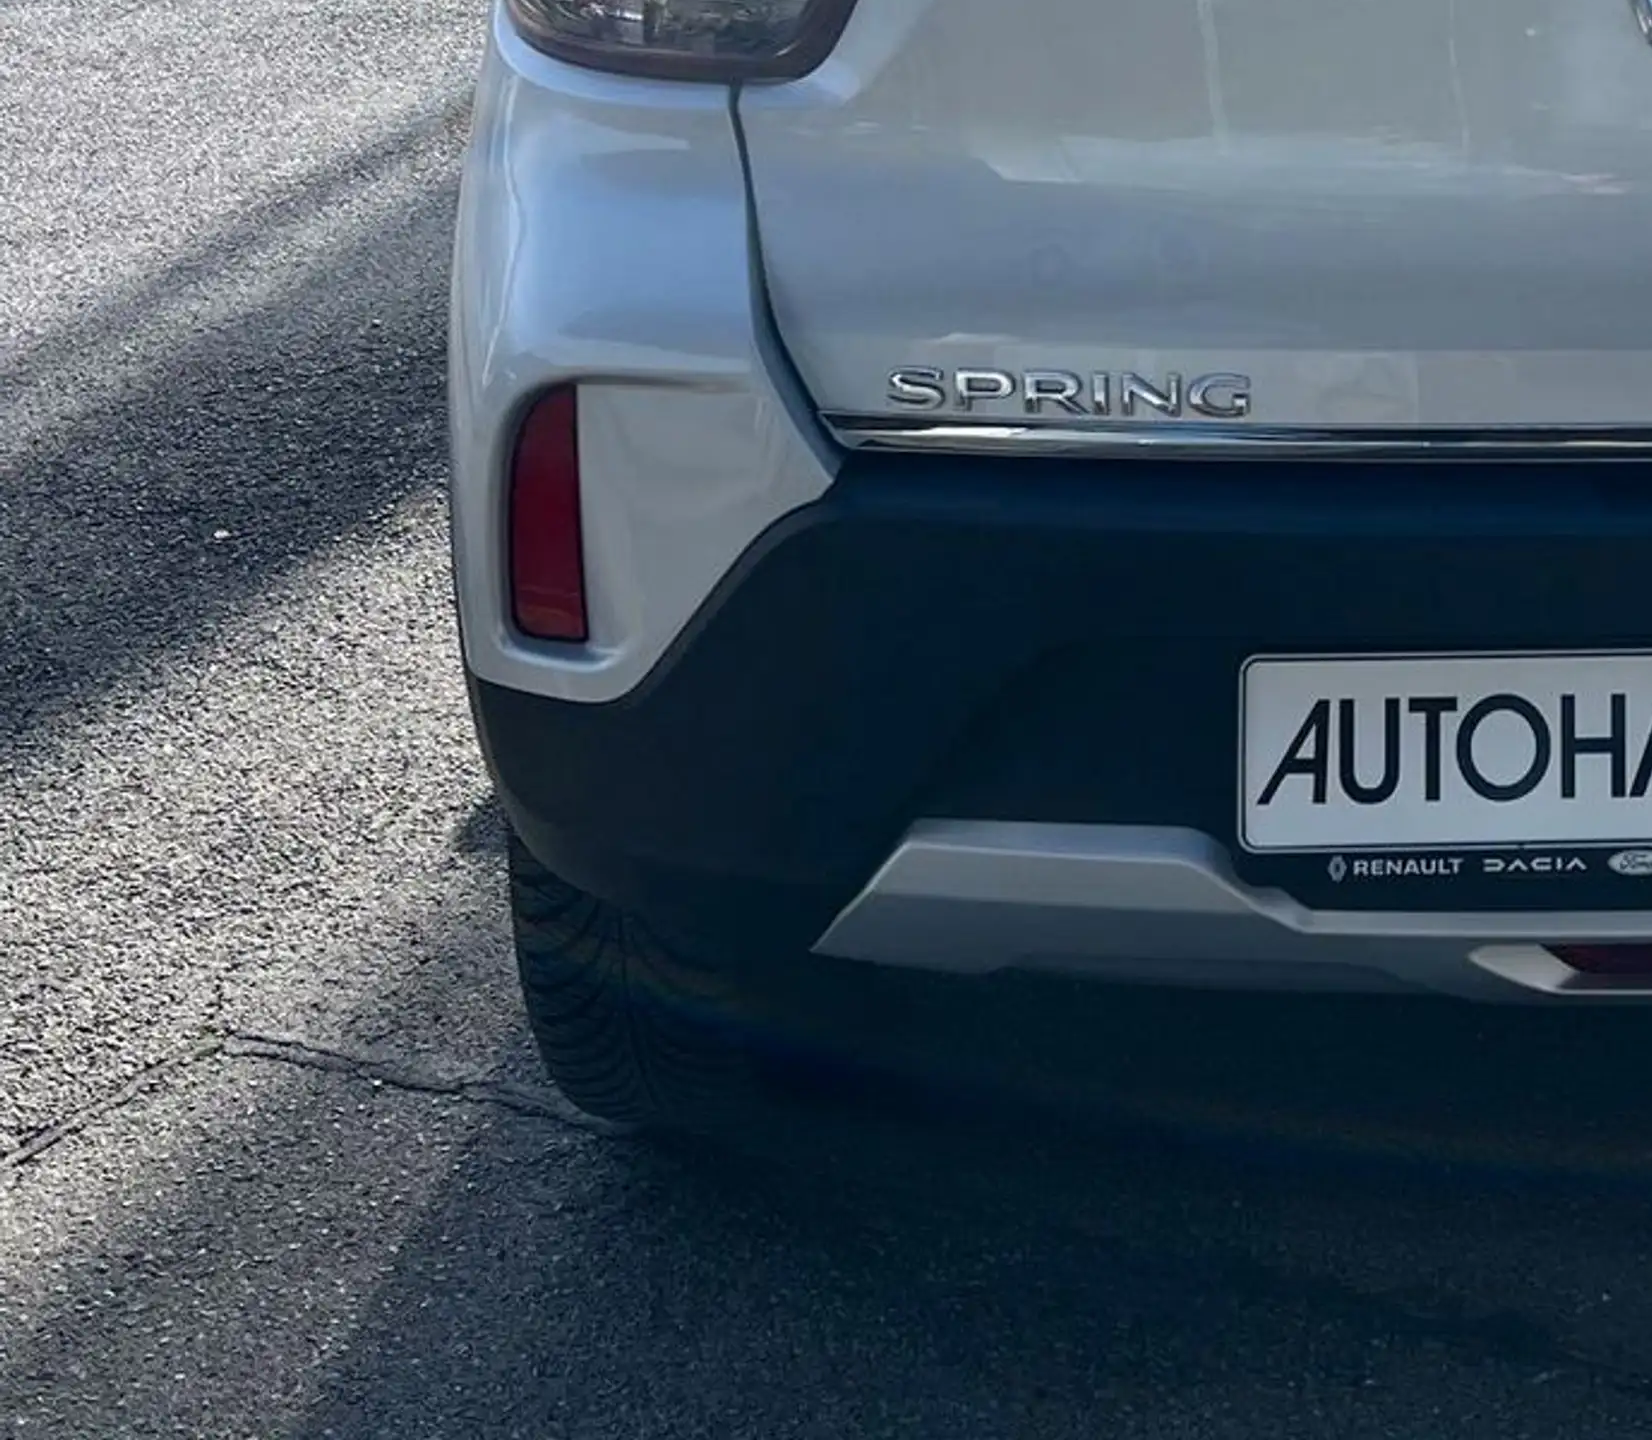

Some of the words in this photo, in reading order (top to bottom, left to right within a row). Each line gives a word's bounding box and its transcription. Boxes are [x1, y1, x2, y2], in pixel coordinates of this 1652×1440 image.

[887, 365, 1251, 418] SPRING
[1352, 858, 1463, 876] RENAULT
[1483, 857, 1587, 873] DACIA
